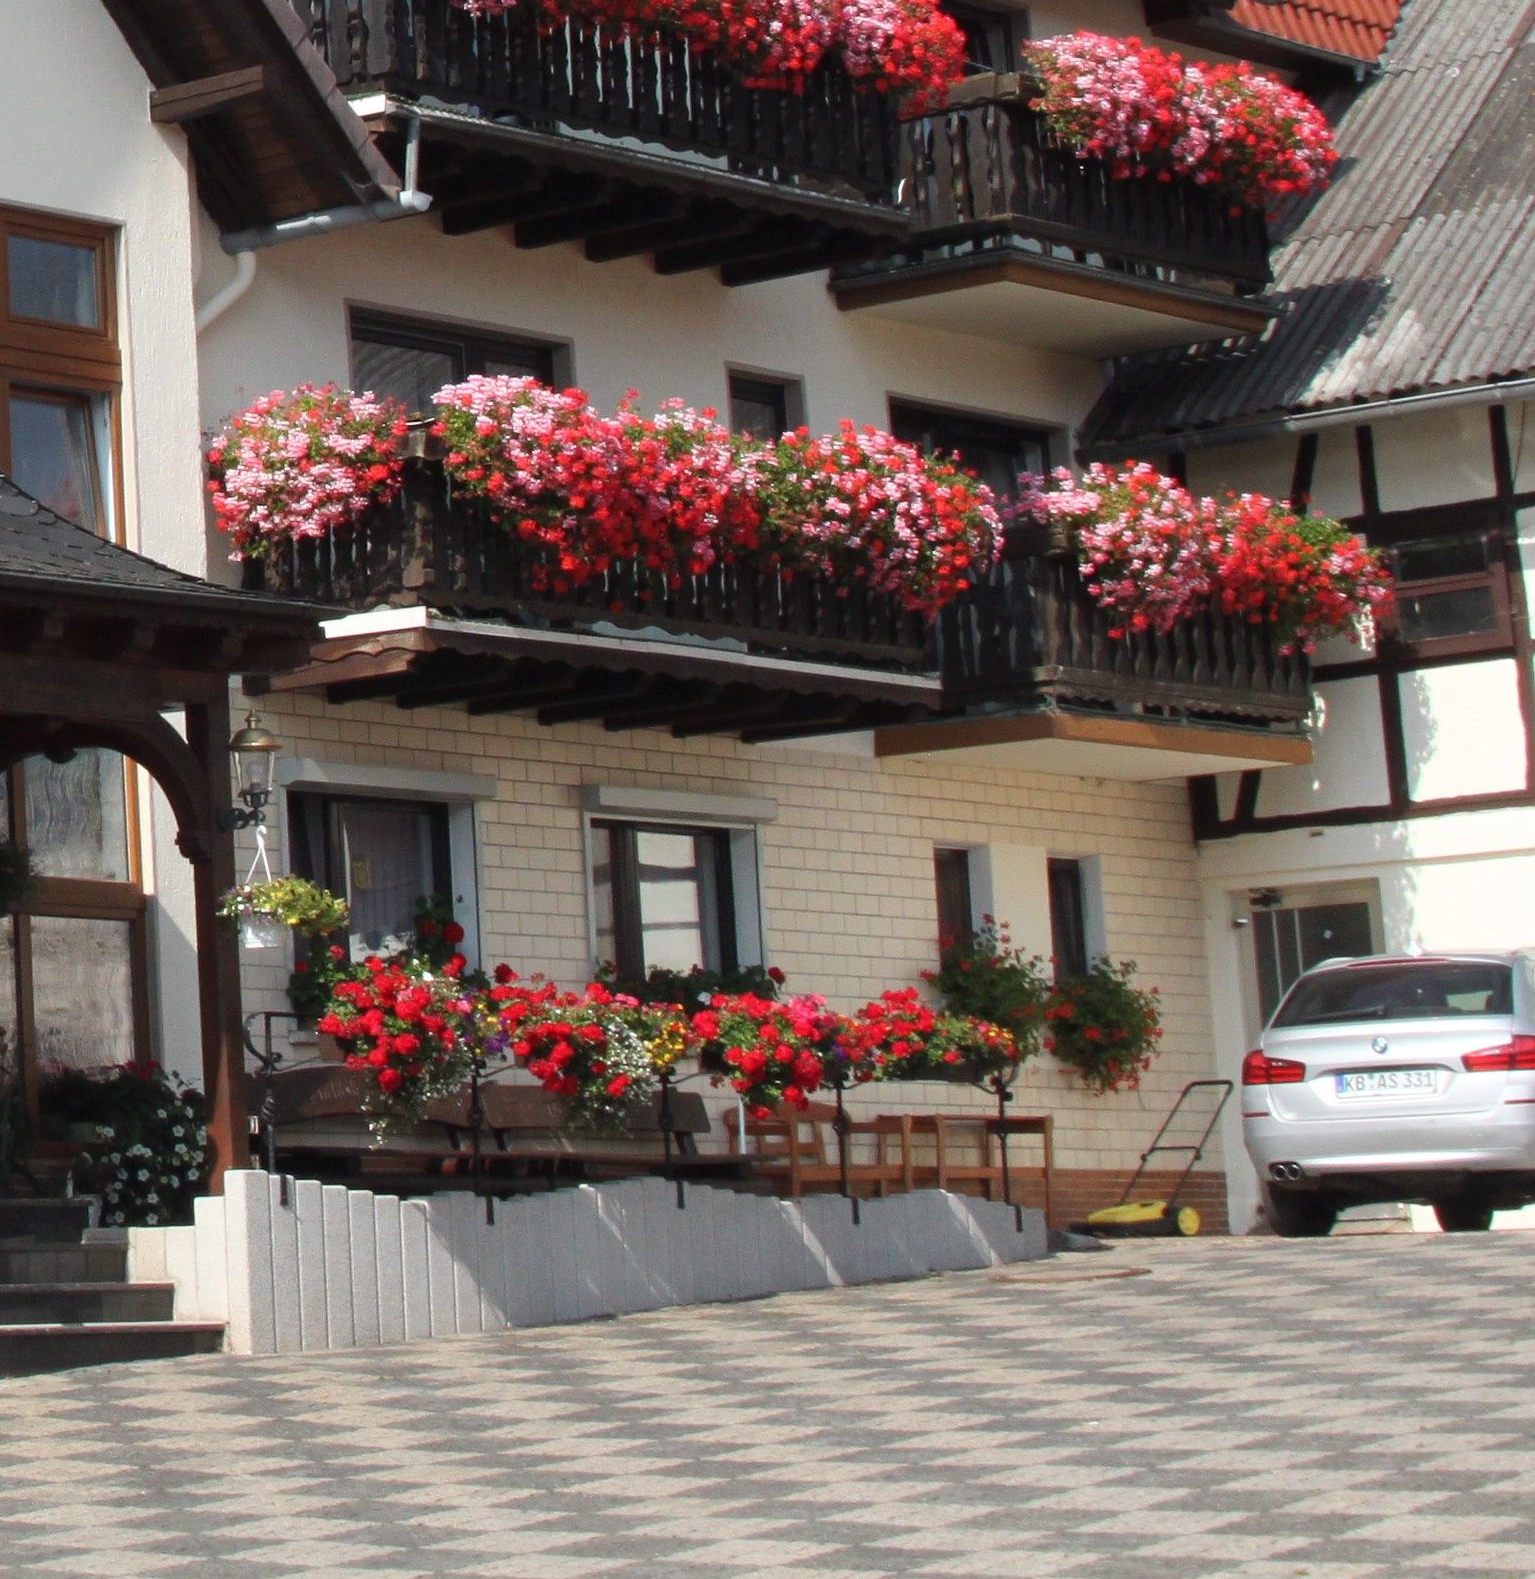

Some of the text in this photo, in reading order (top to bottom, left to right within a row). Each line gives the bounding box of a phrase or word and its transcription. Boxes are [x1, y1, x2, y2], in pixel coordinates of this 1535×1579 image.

[1344, 1072, 1433, 1091] KB AS 331
